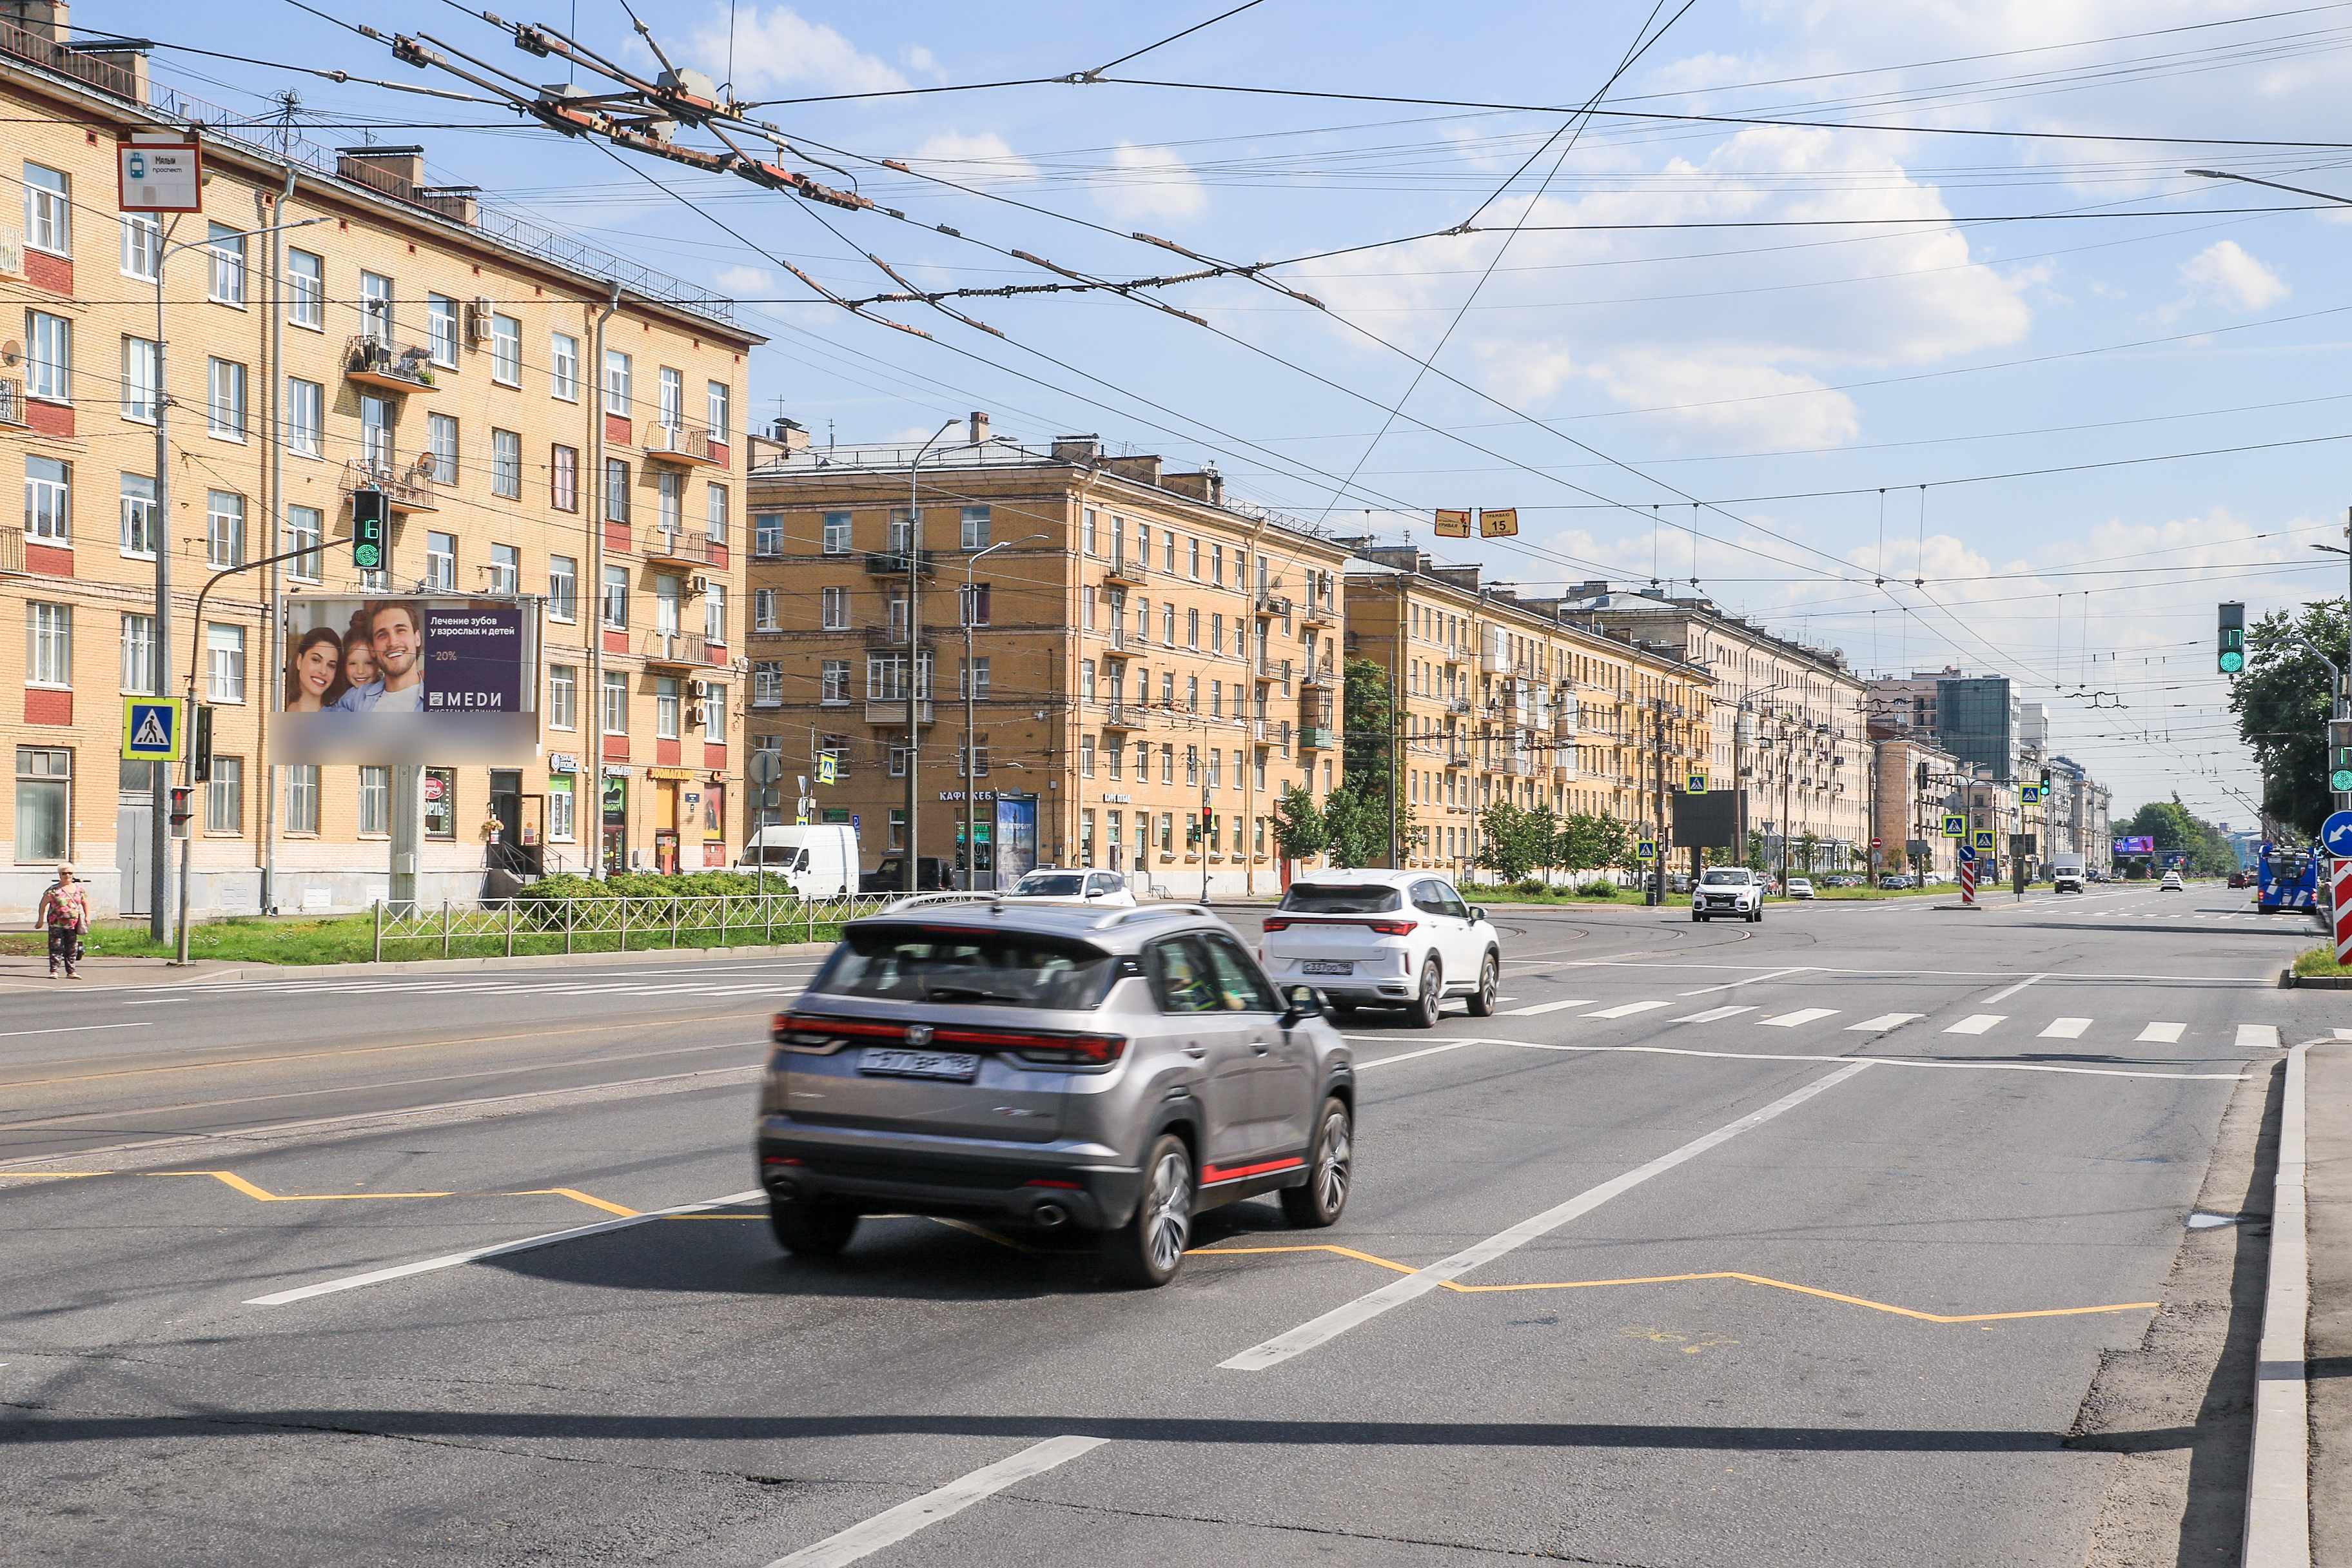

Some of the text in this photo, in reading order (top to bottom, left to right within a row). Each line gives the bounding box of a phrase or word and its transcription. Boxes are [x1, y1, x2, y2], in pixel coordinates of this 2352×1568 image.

[1492, 520, 1506, 531] 15
[430, 616, 498, 626] Лечение зубов
[430, 628, 436, 637] у
[437, 628, 480, 636] взрослых
[488, 627, 515, 636] детей
